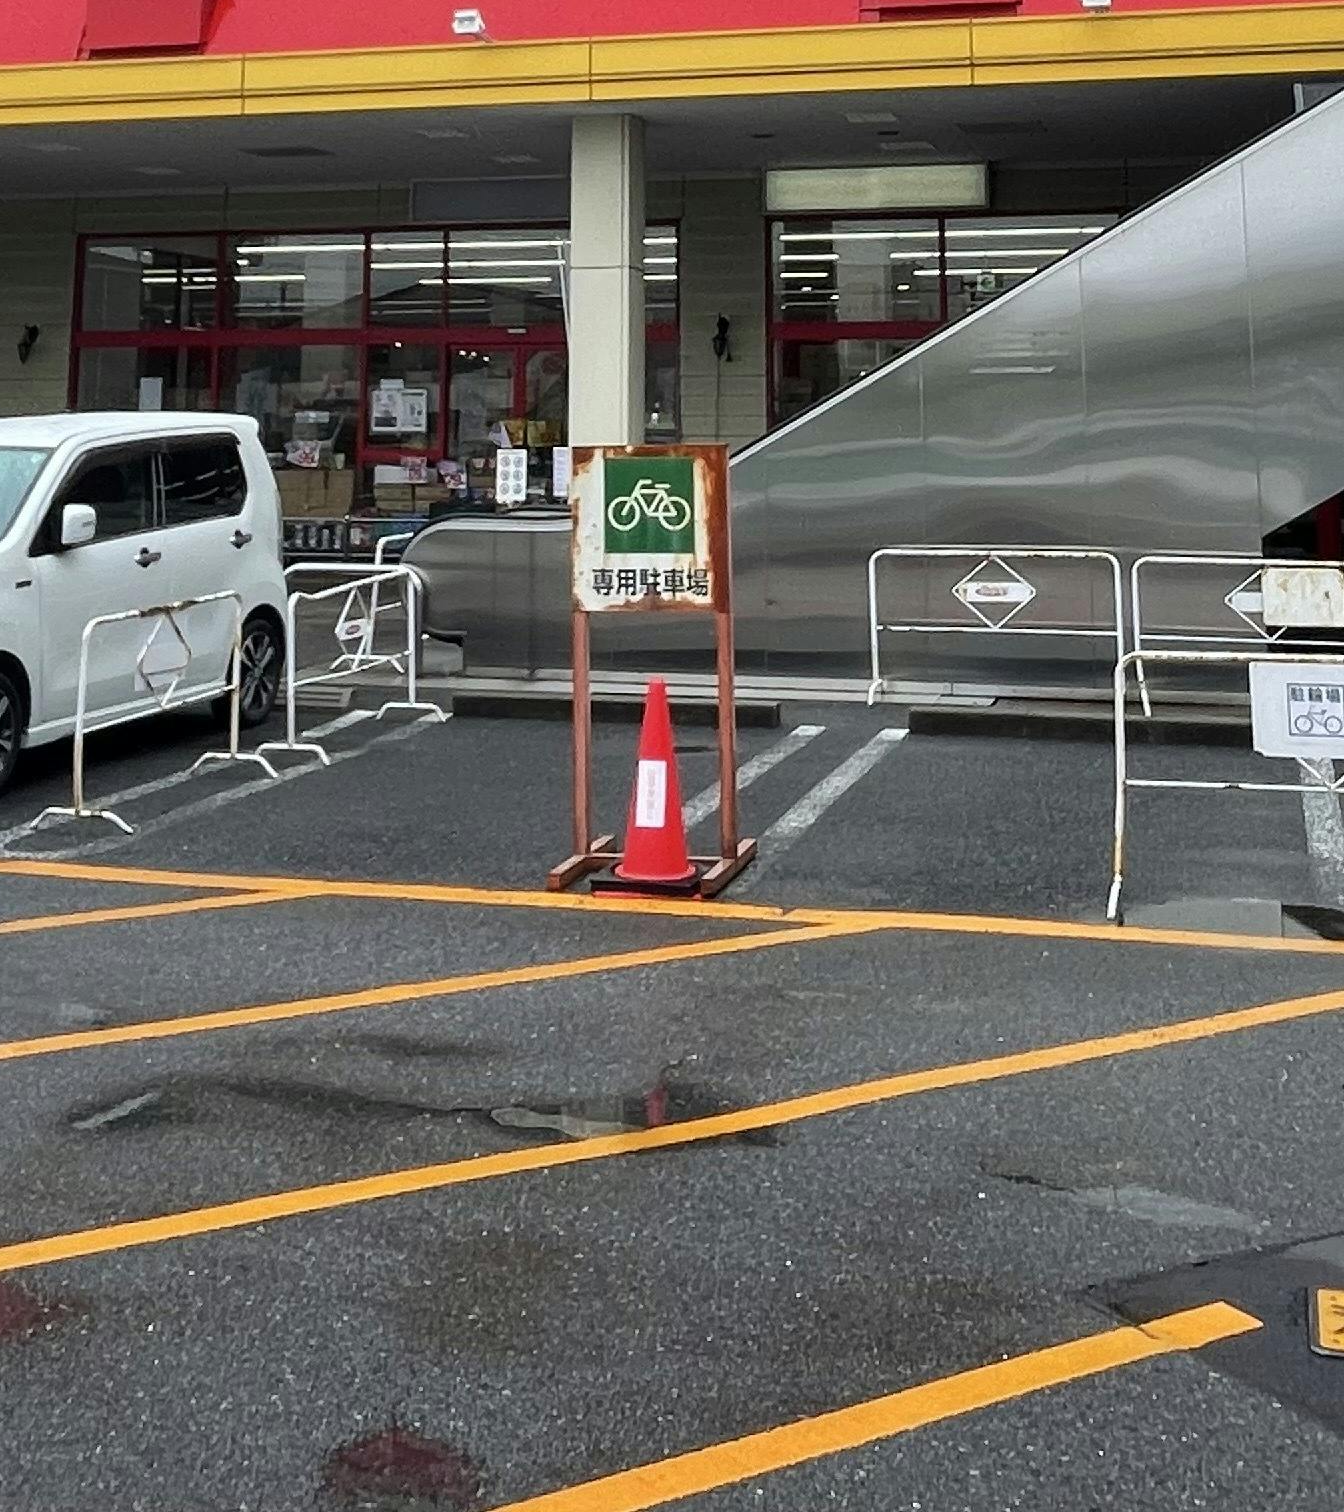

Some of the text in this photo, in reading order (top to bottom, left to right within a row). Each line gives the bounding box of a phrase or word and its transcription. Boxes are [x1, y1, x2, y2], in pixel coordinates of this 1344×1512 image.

[591, 567, 710, 597] 専用駐車場
